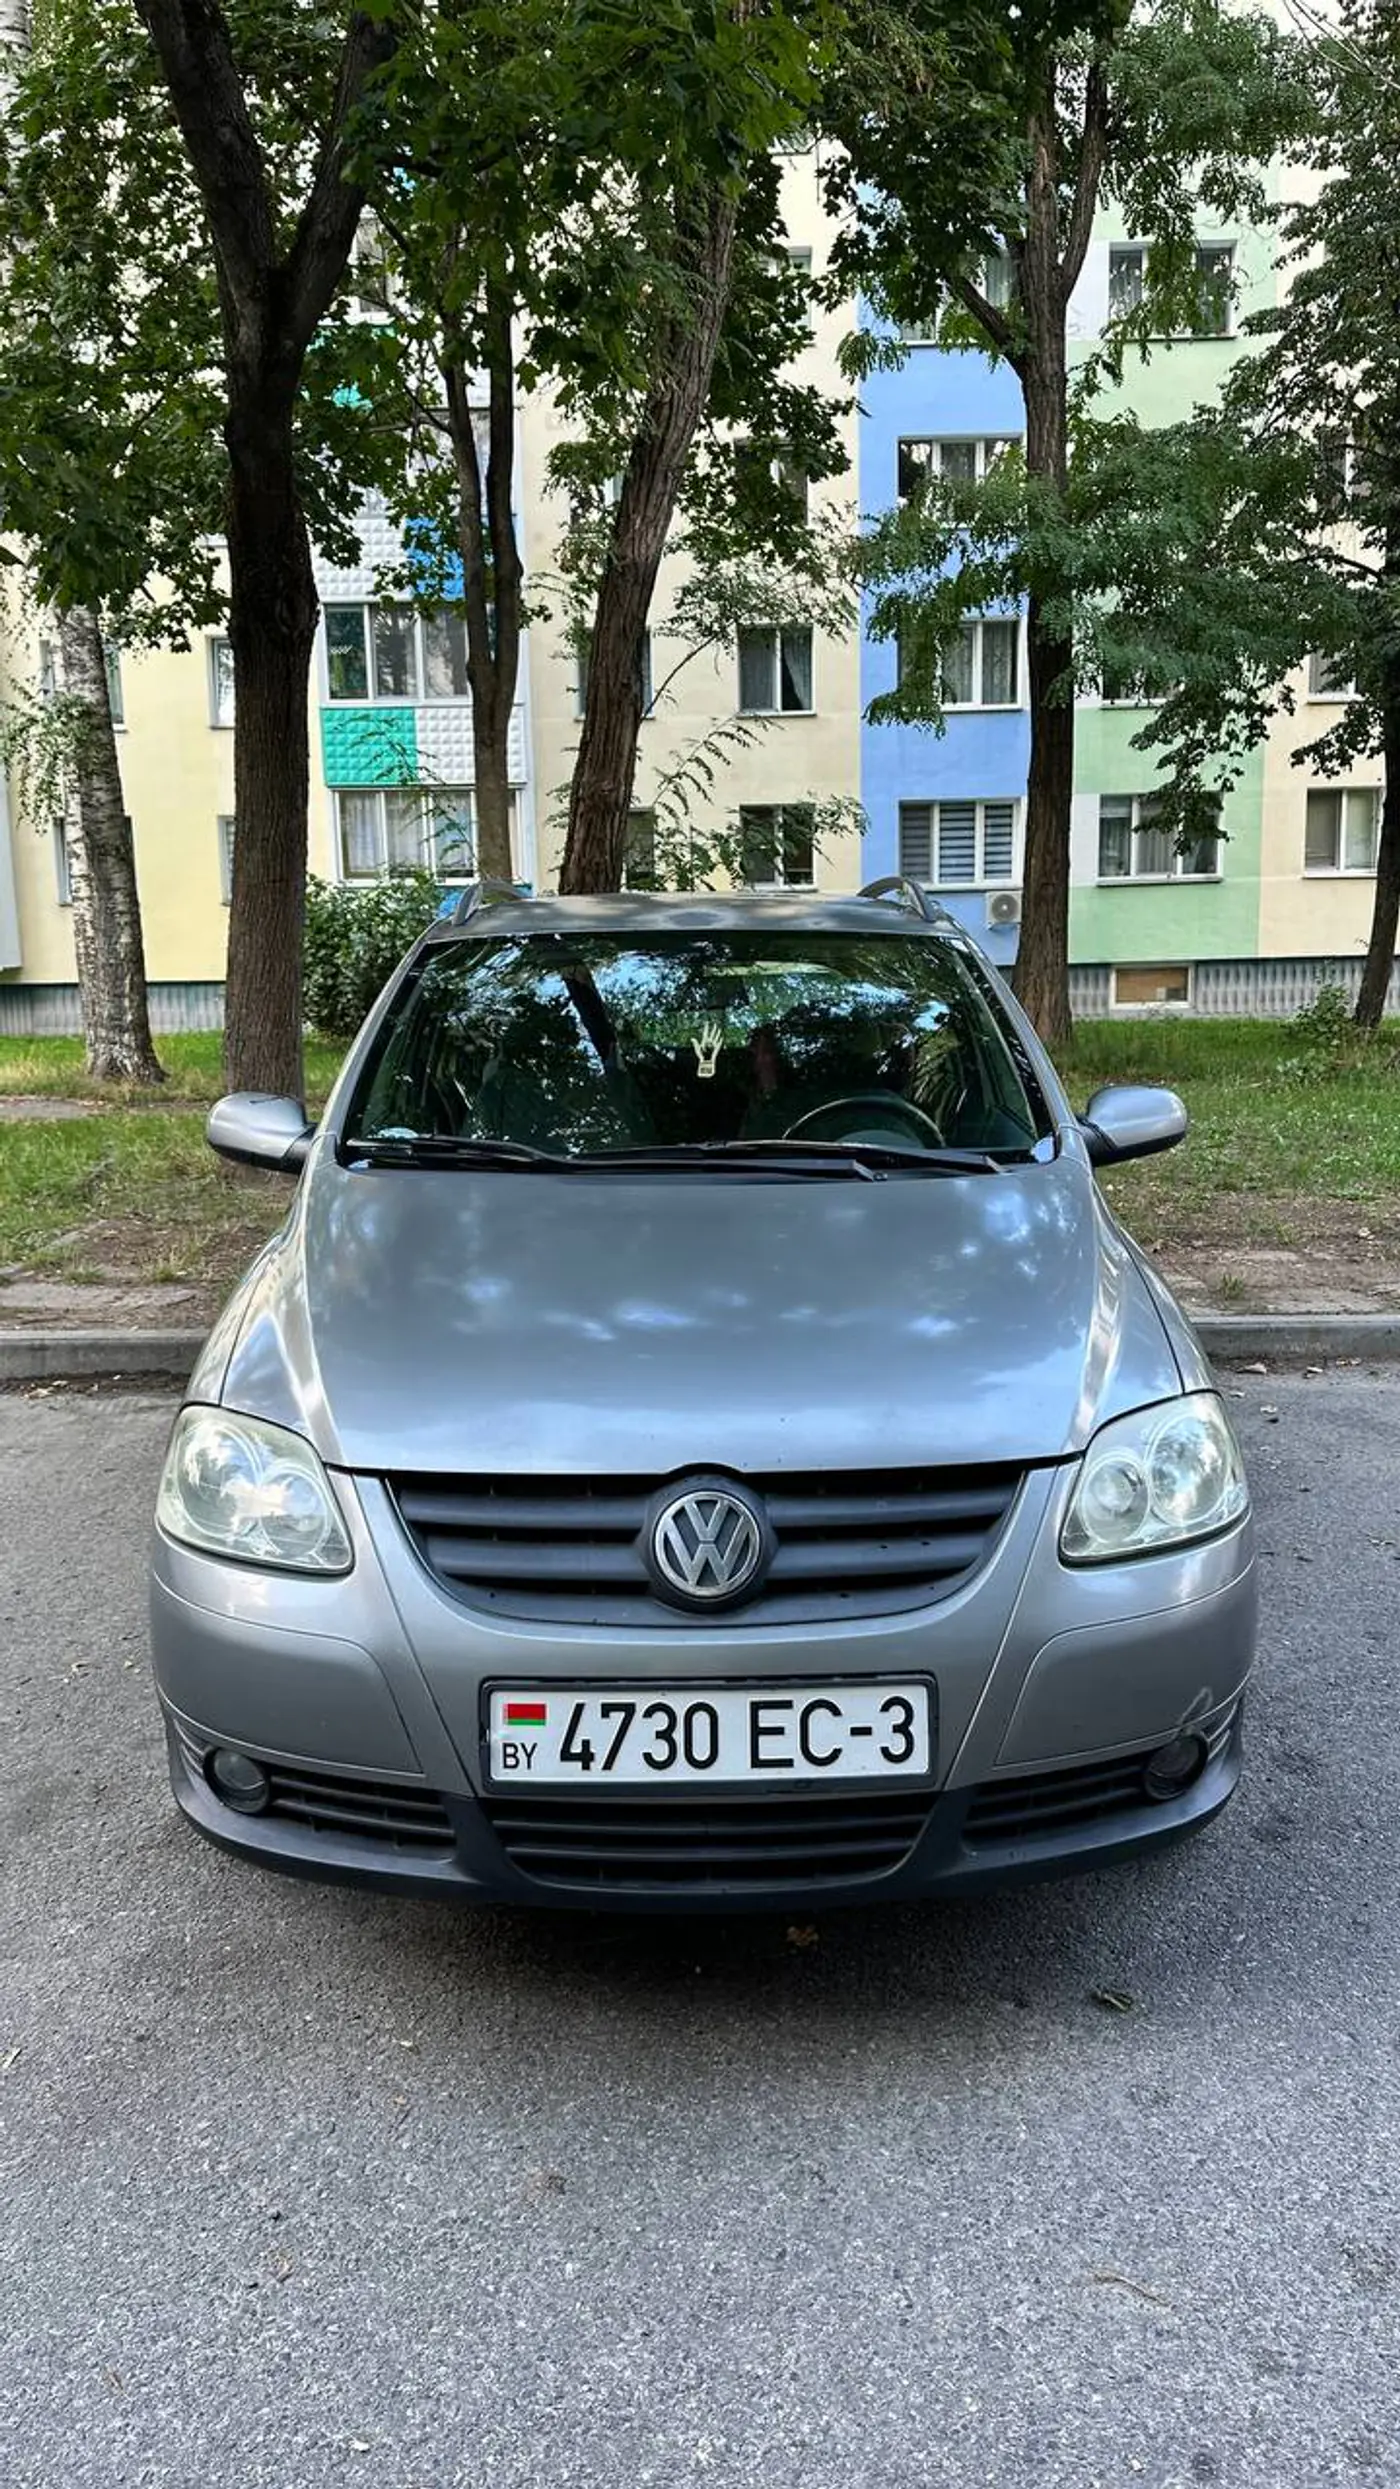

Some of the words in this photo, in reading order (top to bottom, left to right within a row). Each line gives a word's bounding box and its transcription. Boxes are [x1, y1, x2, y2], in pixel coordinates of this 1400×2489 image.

[655, 1491, 760, 1596] VW
[502, 1742, 538, 1770] BY
[559, 1701, 719, 1771] 4730
[750, 1695, 915, 1769] EC-3
